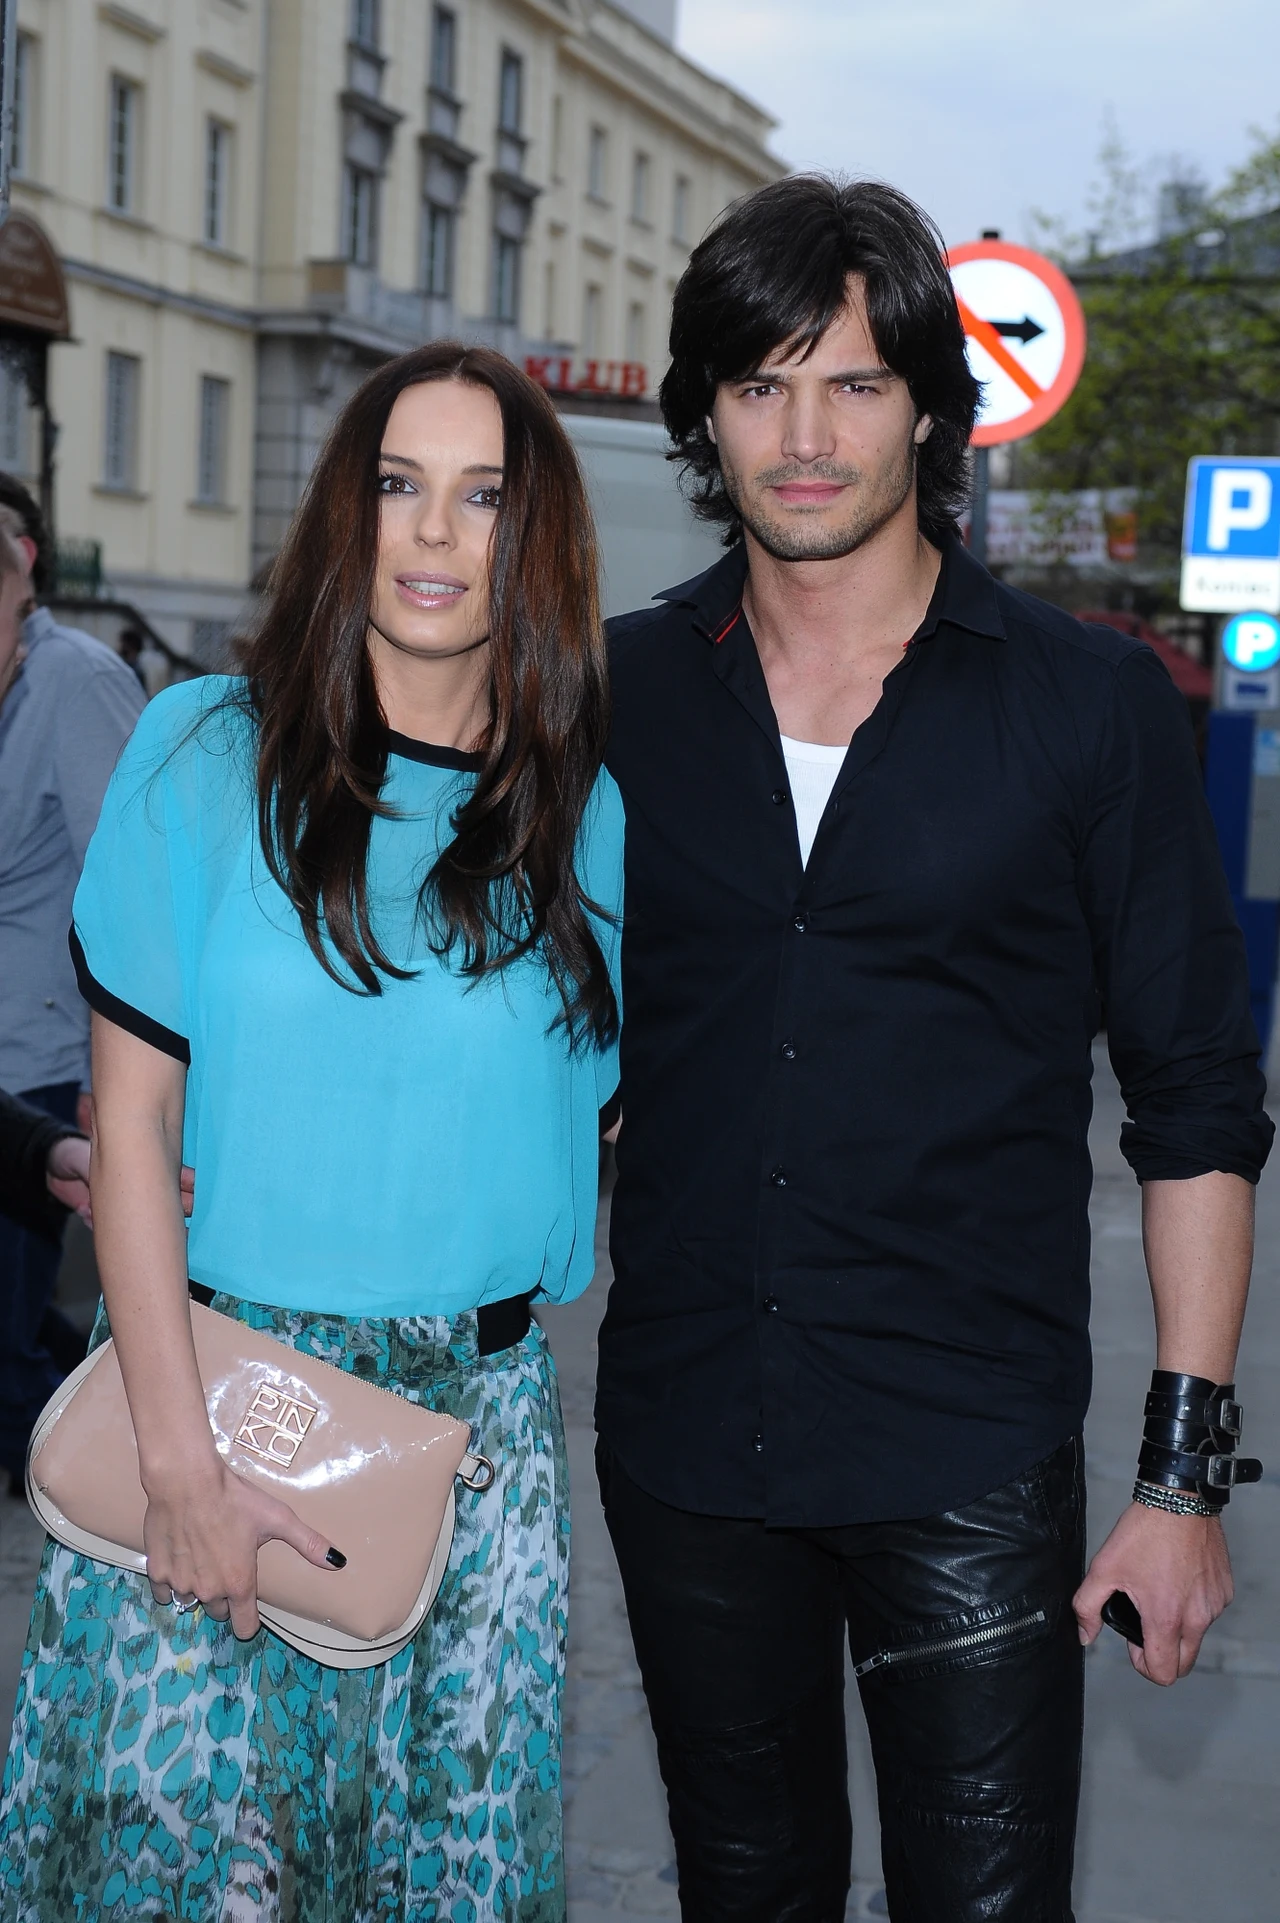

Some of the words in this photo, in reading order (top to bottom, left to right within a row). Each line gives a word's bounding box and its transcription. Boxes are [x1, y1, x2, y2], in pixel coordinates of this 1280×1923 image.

[524, 355, 648, 396] KLUB
[1206, 468, 1273, 551] P
[1235, 620, 1278, 664] P
